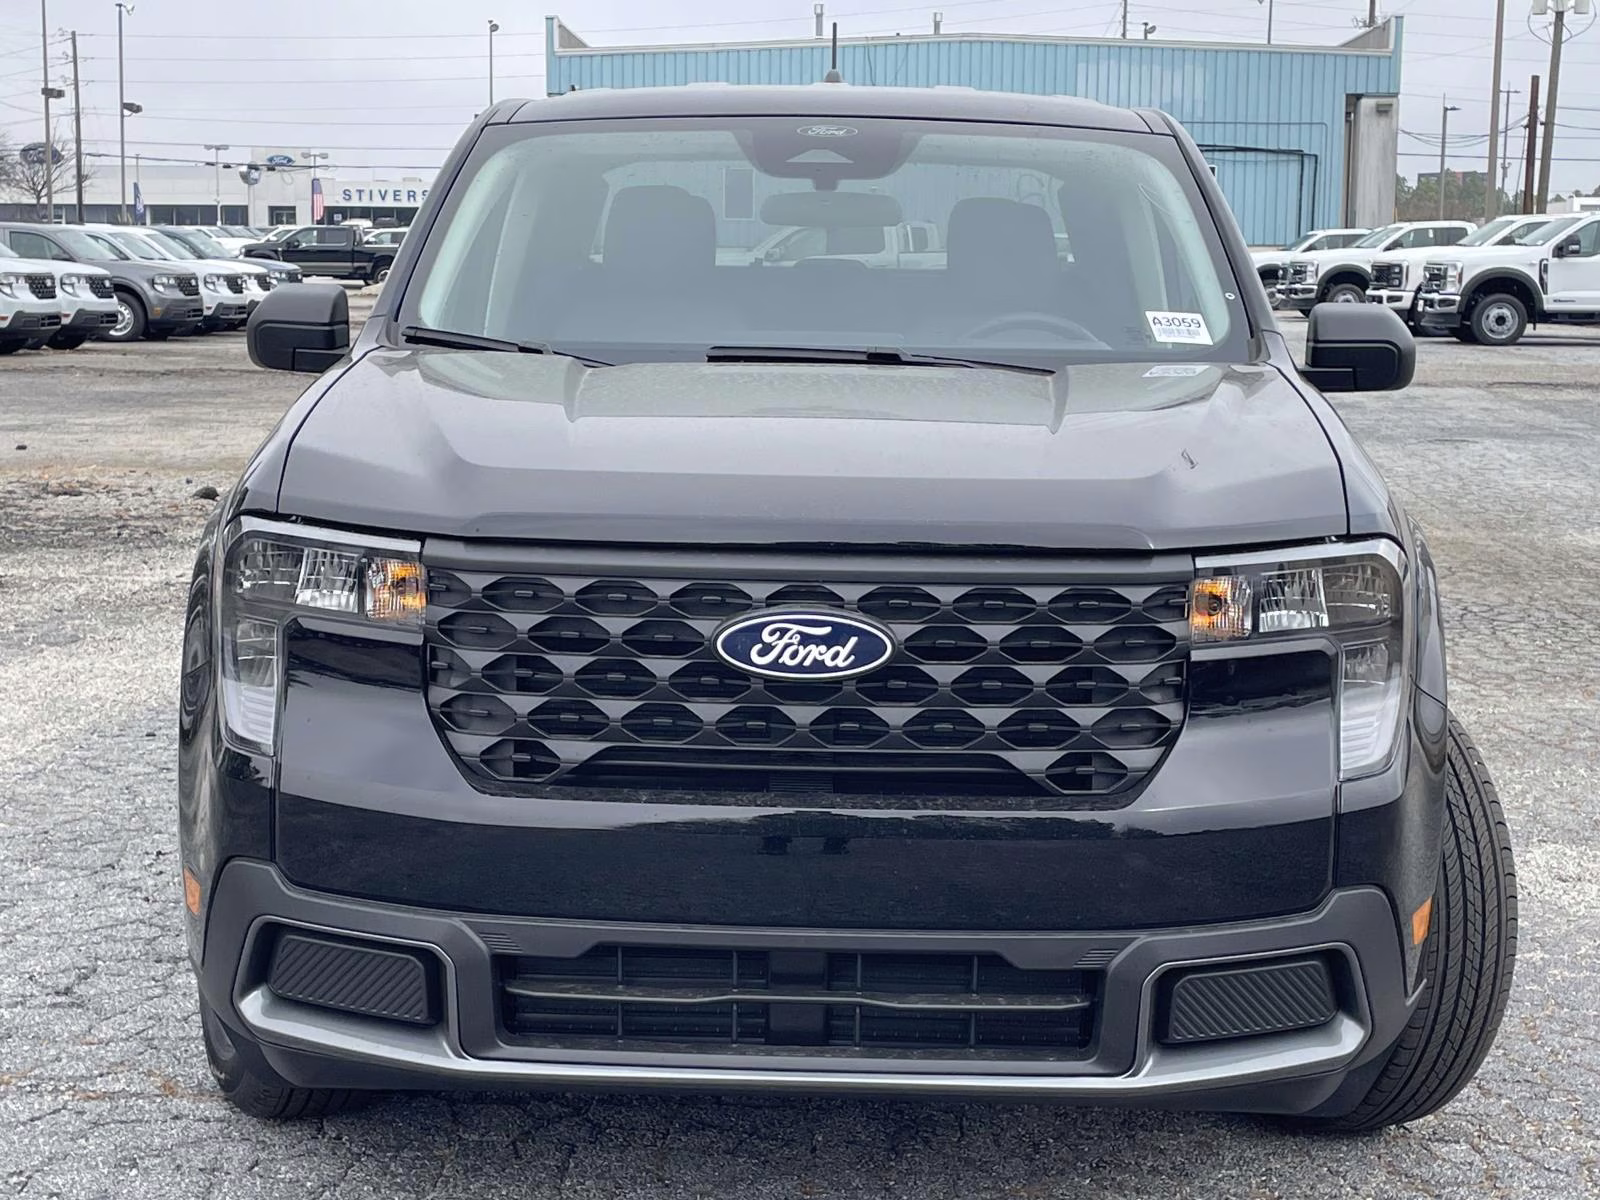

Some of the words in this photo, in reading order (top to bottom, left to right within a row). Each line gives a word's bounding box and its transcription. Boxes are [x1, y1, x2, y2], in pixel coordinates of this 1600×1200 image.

[808, 127, 848, 135] Ford
[1152, 316, 1202, 329] A3059
[750, 622, 859, 668] Ford
